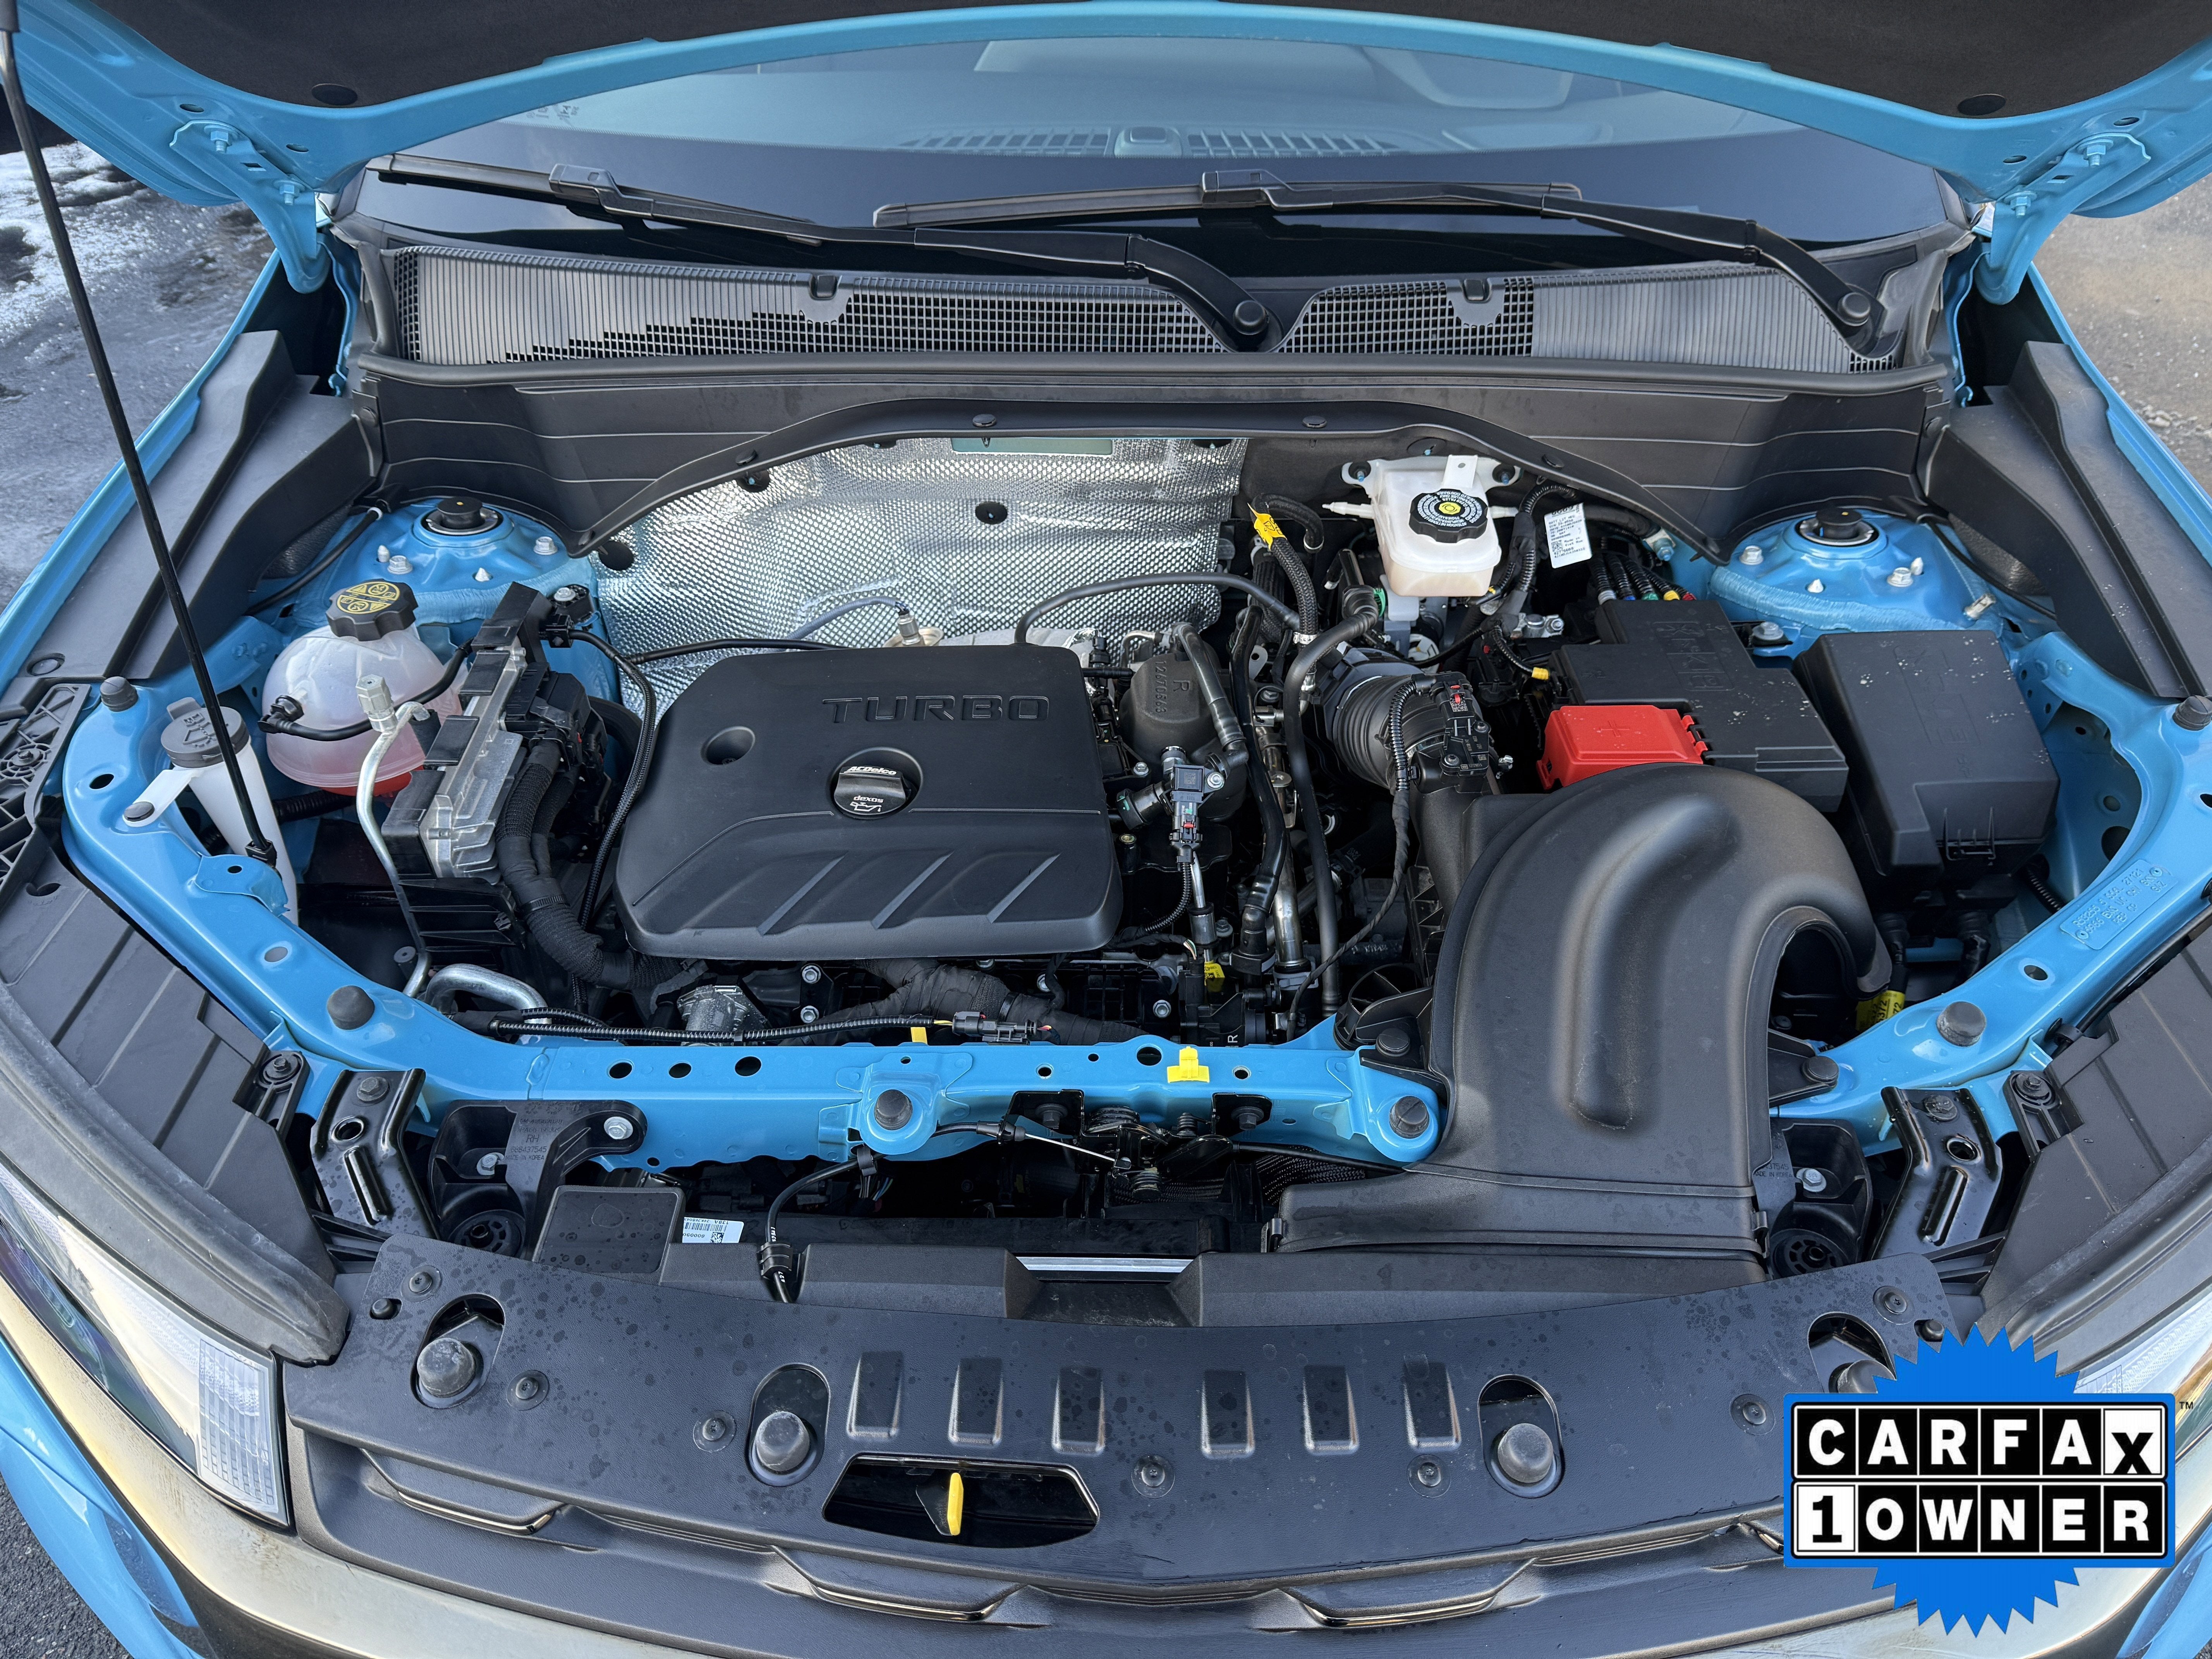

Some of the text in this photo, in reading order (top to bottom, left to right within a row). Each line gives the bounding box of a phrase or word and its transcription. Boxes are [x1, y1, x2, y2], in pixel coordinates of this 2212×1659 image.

[1155, 661, 1167, 713] 12670563
[1173, 680, 1190, 692] R
[822, 695, 1050, 723] TURBO
[846, 766, 897, 775] ACDelco
[1228, 1035, 1238, 1043] R
[526, 1134, 539, 1142] RH
